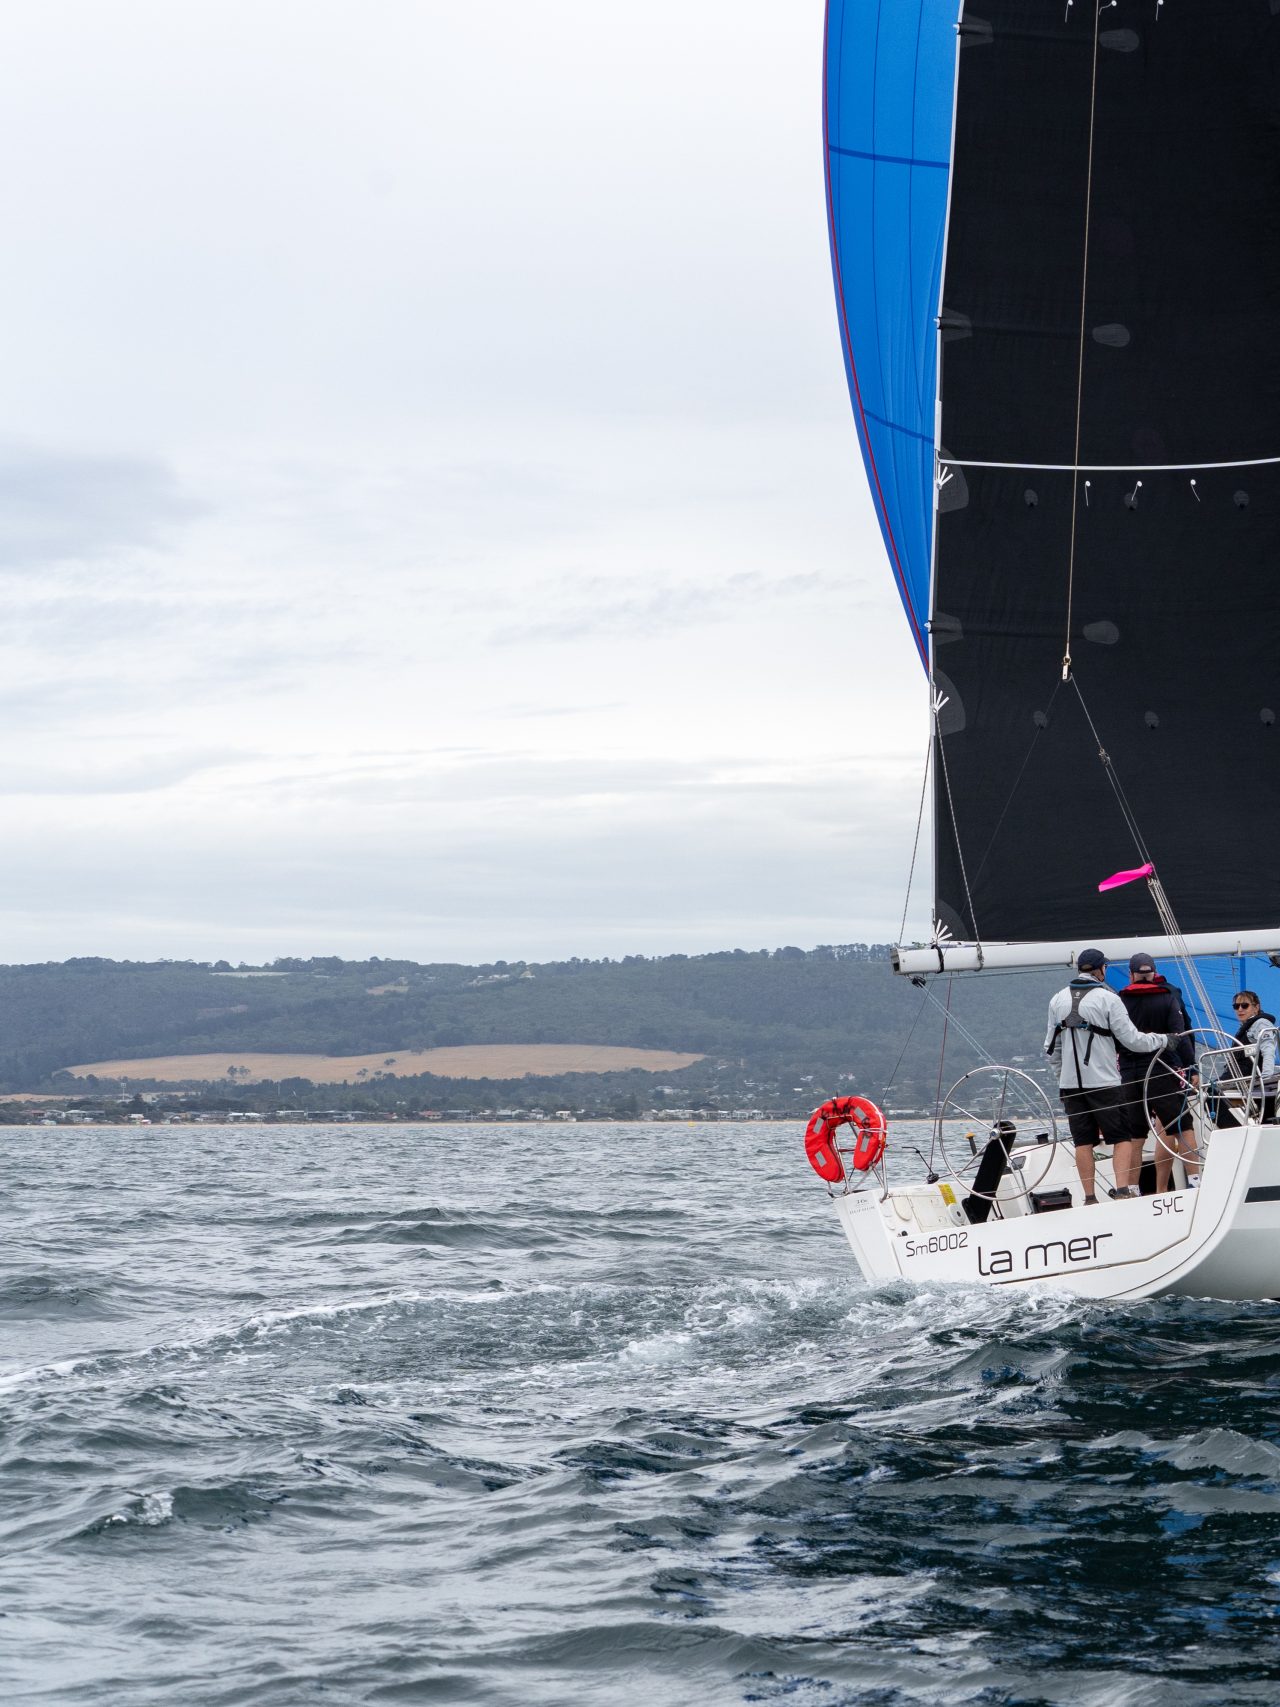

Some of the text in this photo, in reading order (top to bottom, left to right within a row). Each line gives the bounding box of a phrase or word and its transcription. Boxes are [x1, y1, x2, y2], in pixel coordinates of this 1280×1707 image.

[1152, 1196, 1184, 1216] SYC
[978, 1233, 1113, 1276] la mer
